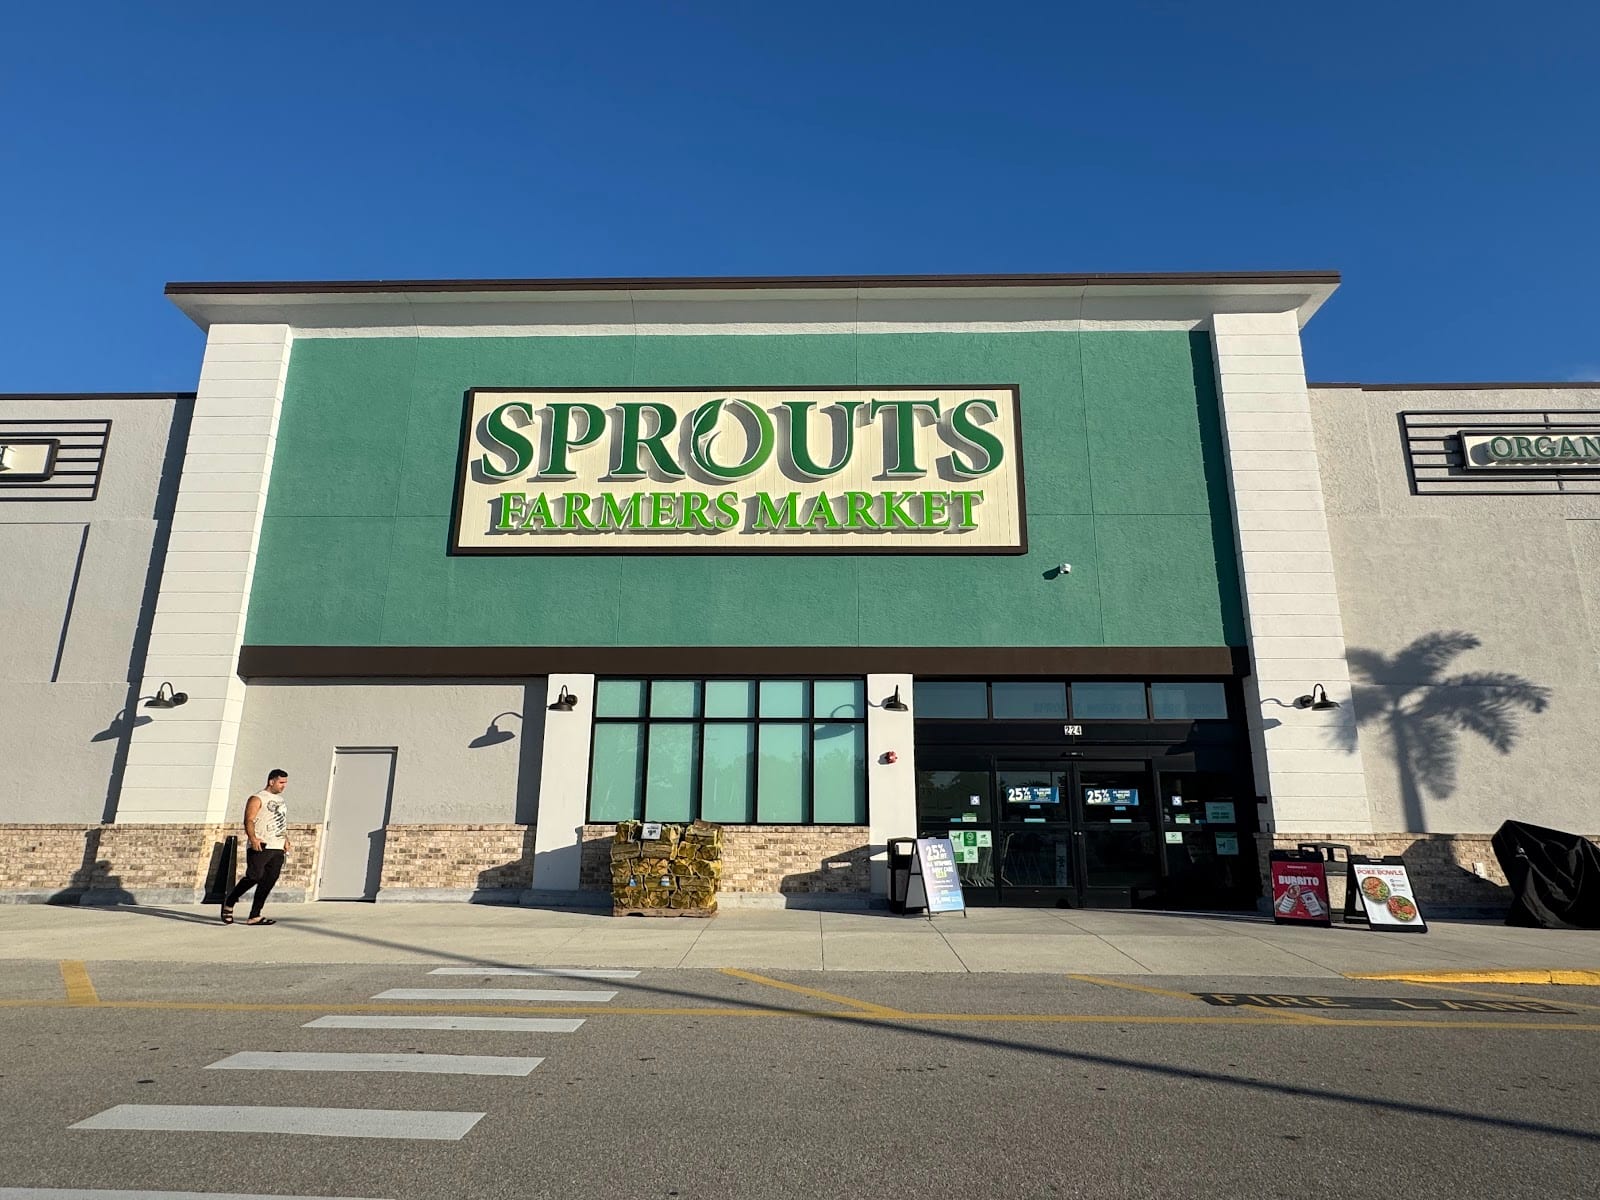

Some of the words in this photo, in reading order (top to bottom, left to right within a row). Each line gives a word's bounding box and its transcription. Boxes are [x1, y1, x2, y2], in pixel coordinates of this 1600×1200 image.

[481, 398, 1004, 478] SPROUTS
[1490, 436, 1600, 458] ORGAN
[496, 491, 740, 530] FARMERS
[753, 489, 985, 529] MARKET
[1065, 726, 1081, 735] 224
[1008, 787, 1031, 802] 25%
[1087, 789, 1110, 804] 25%
[926, 843, 945, 861] 25%
[1278, 874, 1320, 886] BURRITO
[1211, 994, 1350, 1008] FIRE
[1390, 998, 1569, 1013] LANE
